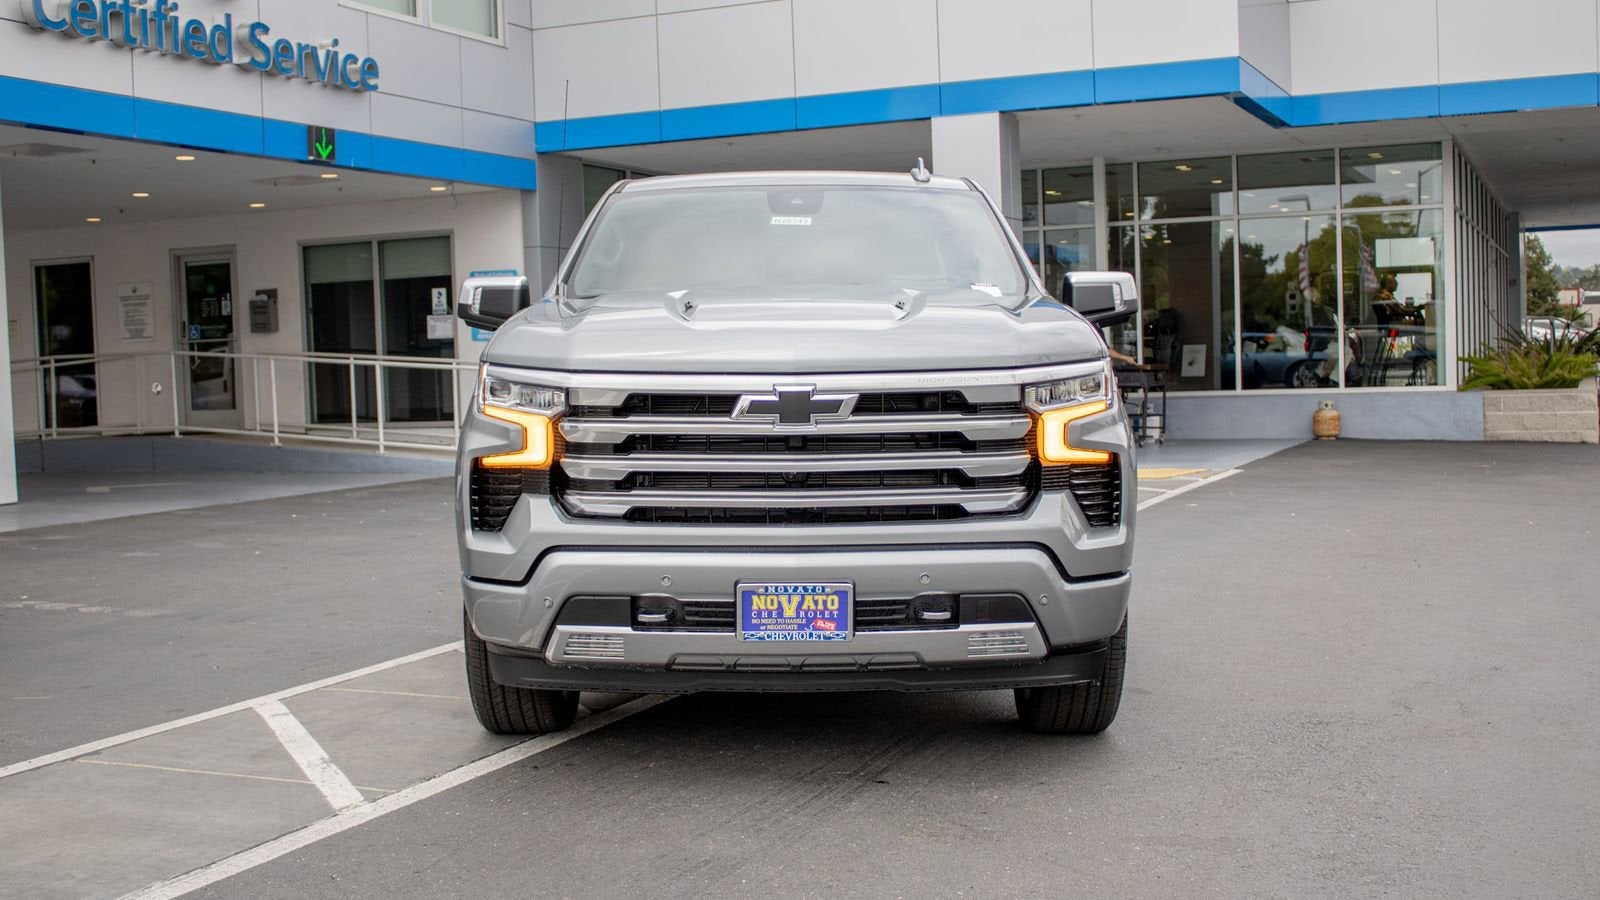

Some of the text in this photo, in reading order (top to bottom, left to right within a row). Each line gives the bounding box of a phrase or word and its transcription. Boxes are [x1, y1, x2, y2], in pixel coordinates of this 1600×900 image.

[31, 0, 379, 91] Certified Service
[751, 594, 840, 617] NOVATO
[764, 632, 824, 640] CHEVROLET
